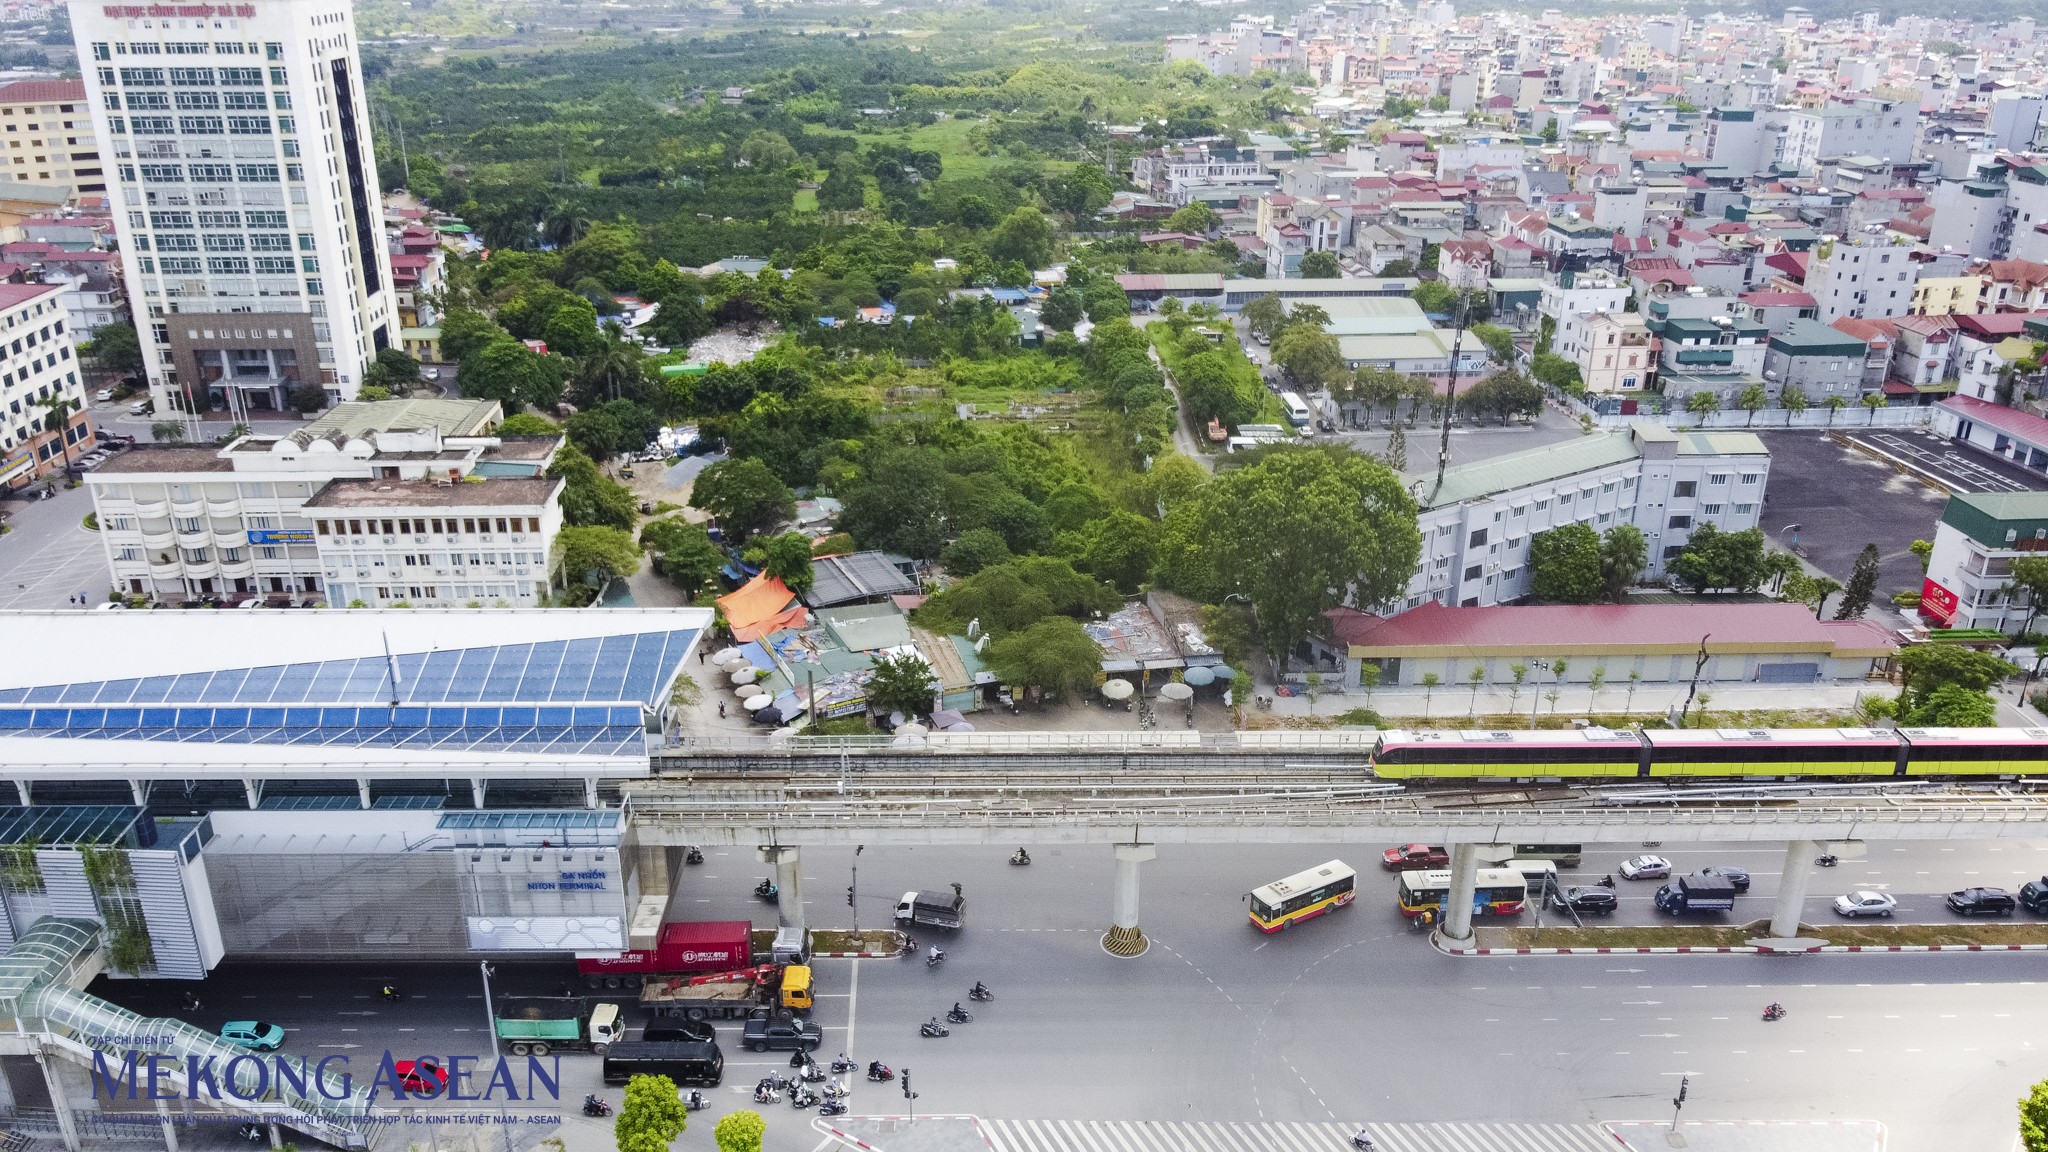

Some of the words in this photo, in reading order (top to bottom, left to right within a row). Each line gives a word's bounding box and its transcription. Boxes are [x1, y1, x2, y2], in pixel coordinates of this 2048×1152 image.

[562, 872, 575, 880] GA
[527, 882, 556, 890] NHON
[558, 882, 606, 890] TERMINAL
